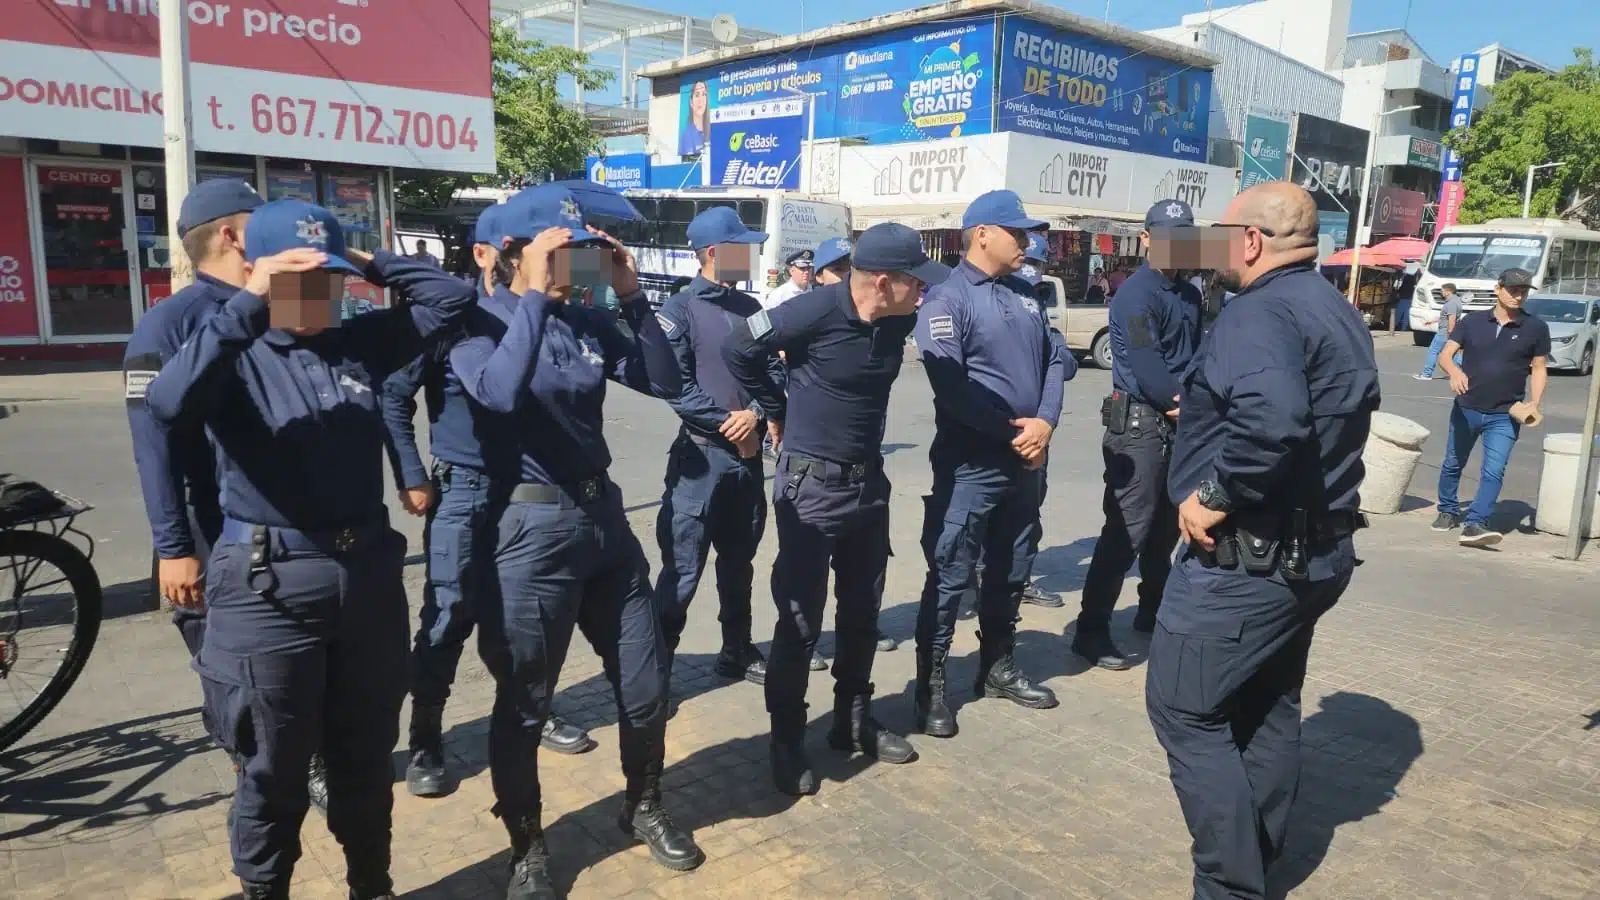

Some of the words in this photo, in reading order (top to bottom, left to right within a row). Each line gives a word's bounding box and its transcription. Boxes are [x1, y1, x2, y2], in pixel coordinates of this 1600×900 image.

[243, 7, 361, 46] precio
[777, 58, 798, 73] más
[857, 50, 893, 66] Maxilana
[923, 64, 933, 75] MI
[933, 60, 962, 73] PRIMER
[1014, 31, 1119, 81] RECIBIMOS
[718, 85, 733, 101] por
[733, 84, 742, 96] tu
[742, 78, 773, 97] joyería
[773, 78, 780, 92] y
[782, 71, 821, 89] artículos
[909, 70, 977, 98] EMPEÑO
[1023, 66, 1052, 97] DE
[1056, 73, 1107, 108] TODO
[912, 91, 973, 116] GRATIS
[207, 95, 236, 131] t.
[251, 93, 480, 153] 667.712.7004
[744, 133, 779, 149] ceBasic
[908, 146, 969, 167] IMPORT
[1068, 152, 1109, 172] IMPORT
[48, 170, 112, 183] CENTRO
[605, 165, 641, 181] Maxilana
[738, 160, 785, 185] telcel
[908, 164, 966, 194] CITY
[1067, 169, 1107, 199] CITY
[1177, 168, 1208, 185] IMPORT
